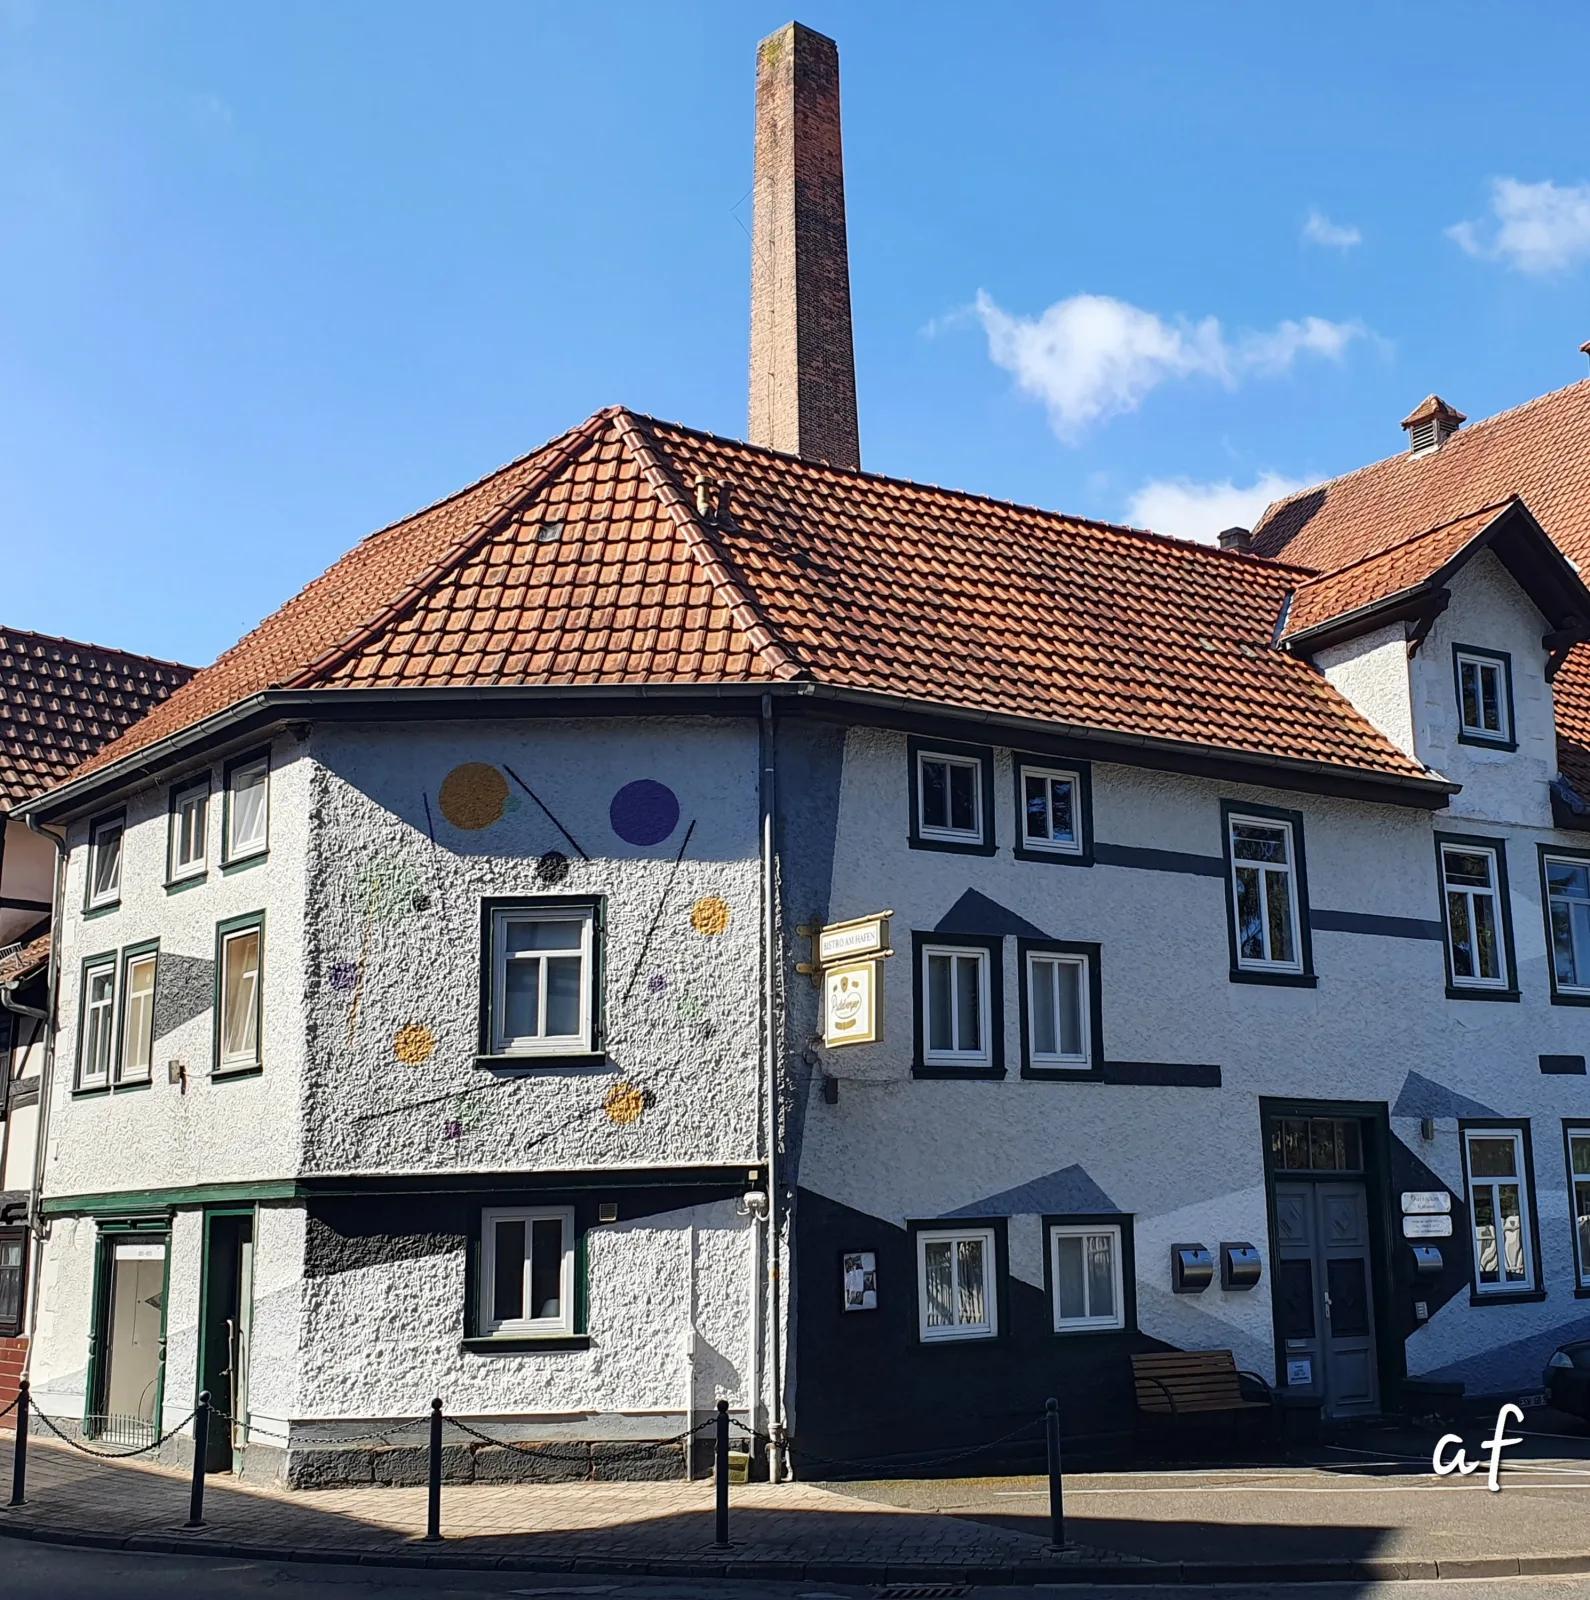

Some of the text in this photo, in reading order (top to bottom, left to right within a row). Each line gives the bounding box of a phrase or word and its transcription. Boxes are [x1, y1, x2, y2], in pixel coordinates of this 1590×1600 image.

[823, 931, 875, 950] BISTRO AM HAFEN
